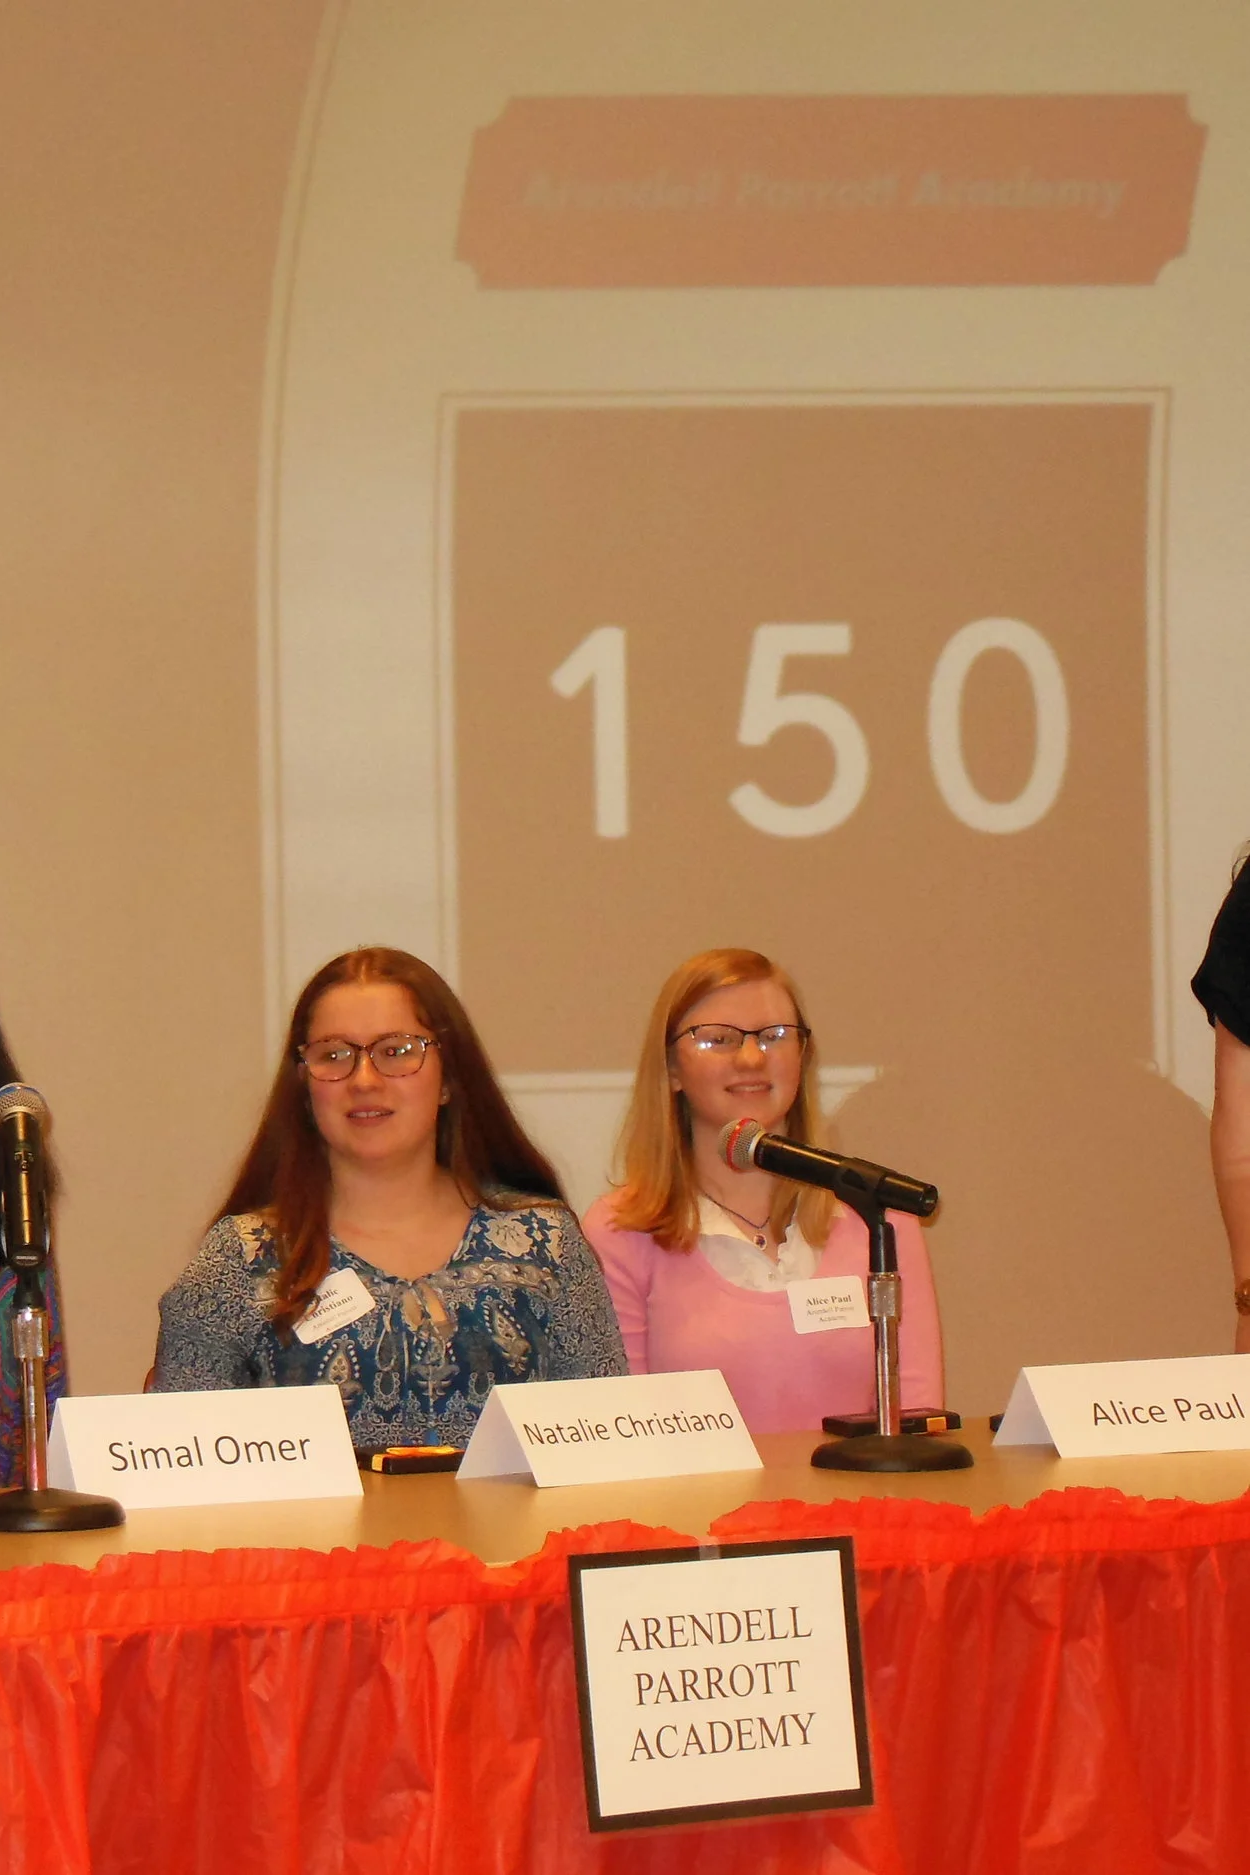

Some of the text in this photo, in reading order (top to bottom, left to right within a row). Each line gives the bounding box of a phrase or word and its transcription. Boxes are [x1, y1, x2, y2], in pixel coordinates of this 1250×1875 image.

[806, 1294, 852, 1307] Alice Paul
[523, 1410, 735, 1445] Natalie Christiano
[1093, 1393, 1245, 1426] Alice Paul
[108, 1435, 311, 1472] Simal Omer
[616, 1606, 813, 1652] ARENDELL
[634, 1660, 801, 1706] PARROTT
[629, 1712, 816, 1762] ACADEMY
